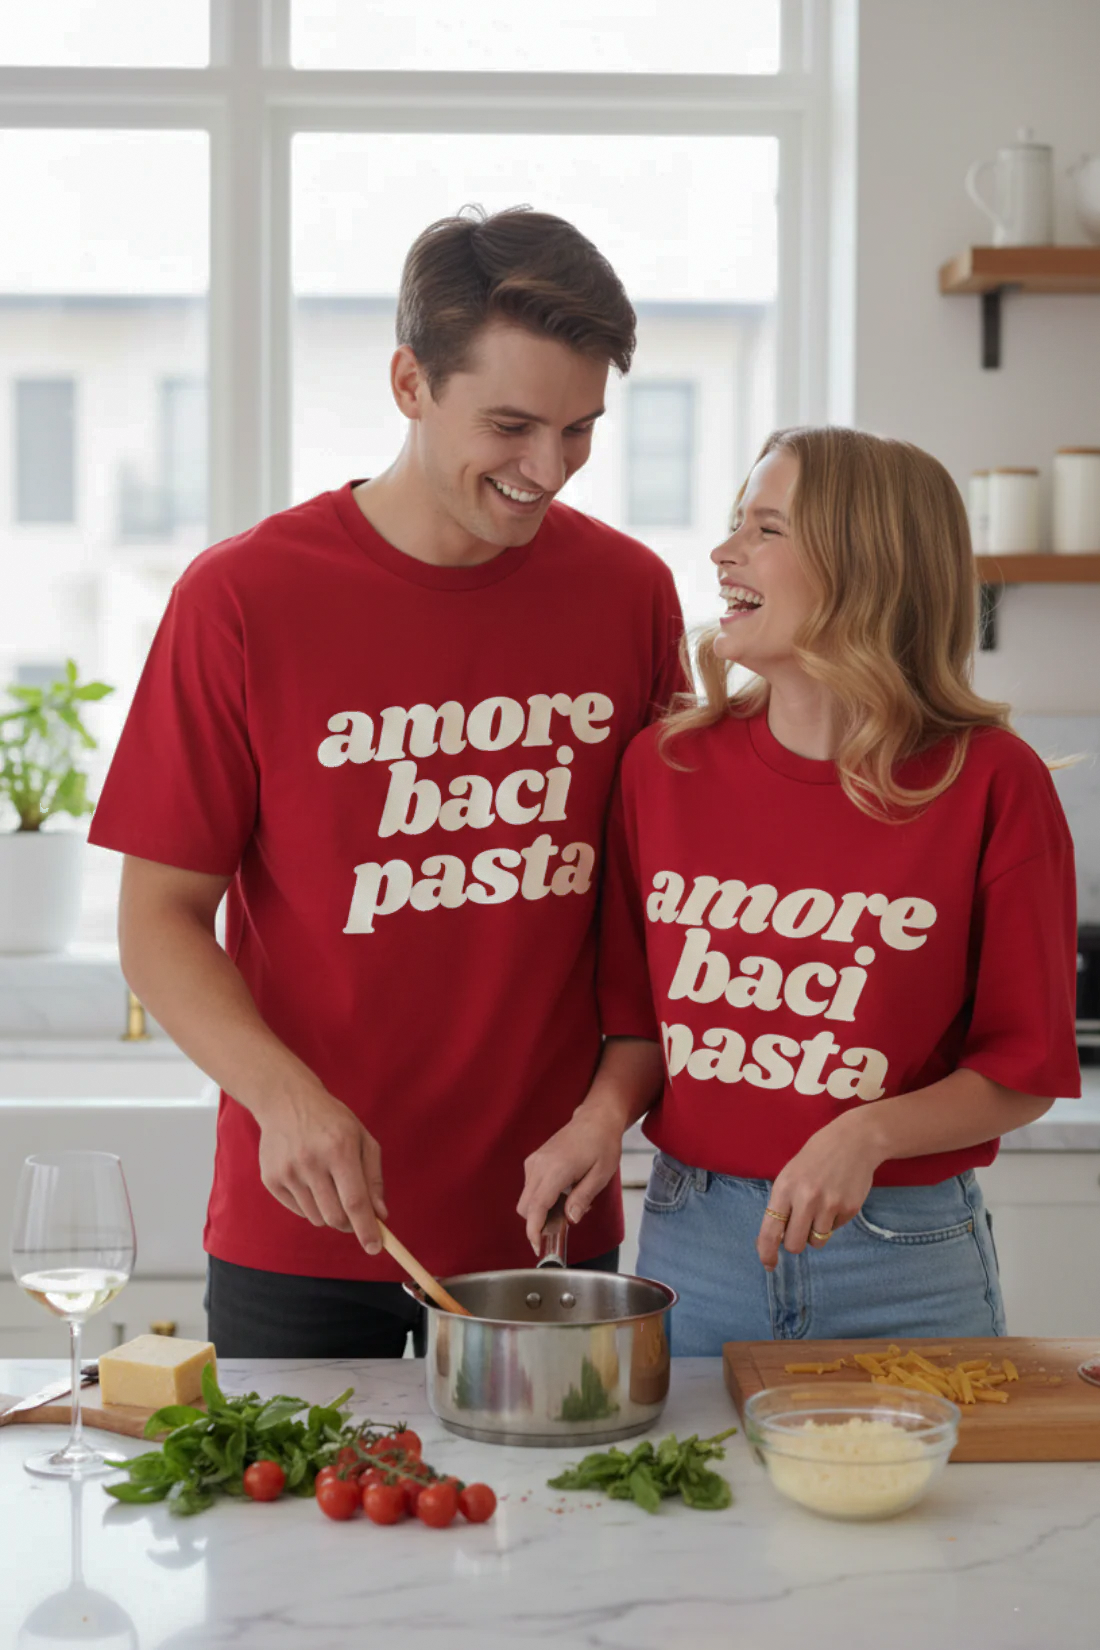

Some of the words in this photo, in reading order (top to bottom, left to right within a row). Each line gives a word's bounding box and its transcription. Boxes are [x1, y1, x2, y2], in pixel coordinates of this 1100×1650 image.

[317, 692, 614, 768] amore
[377, 745, 574, 838] baci
[342, 833, 595, 934] pasta
[646, 870, 937, 951] amore
[667, 926, 876, 1022] baci
